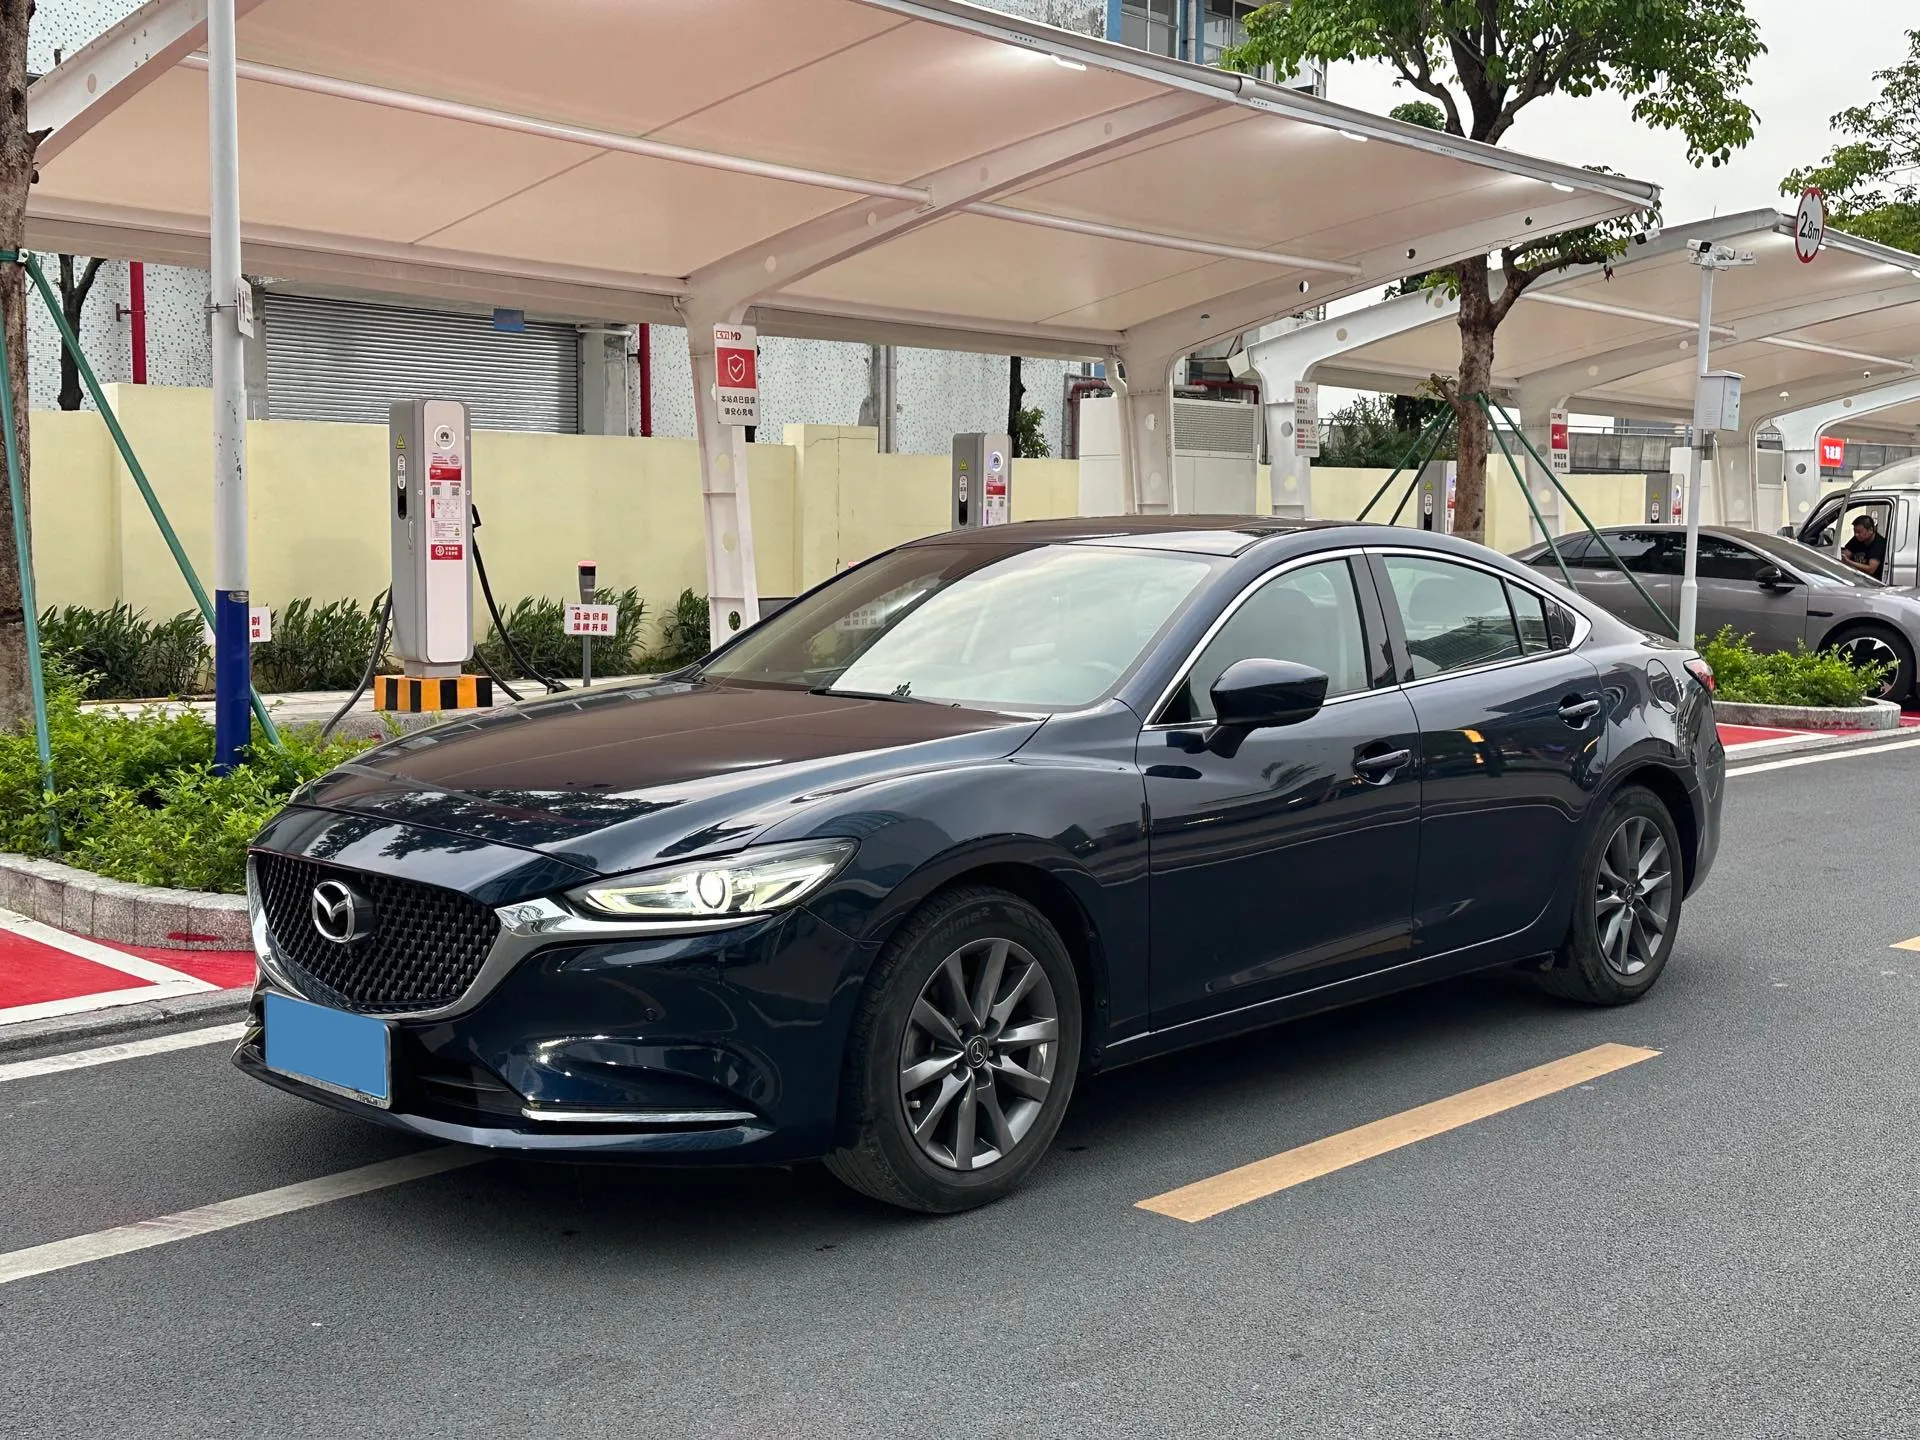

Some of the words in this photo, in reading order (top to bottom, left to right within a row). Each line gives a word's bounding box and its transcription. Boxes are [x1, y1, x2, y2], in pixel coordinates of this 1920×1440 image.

[1799, 211, 1820, 240] 2.8m
[575, 612, 608, 621] 自动识别
